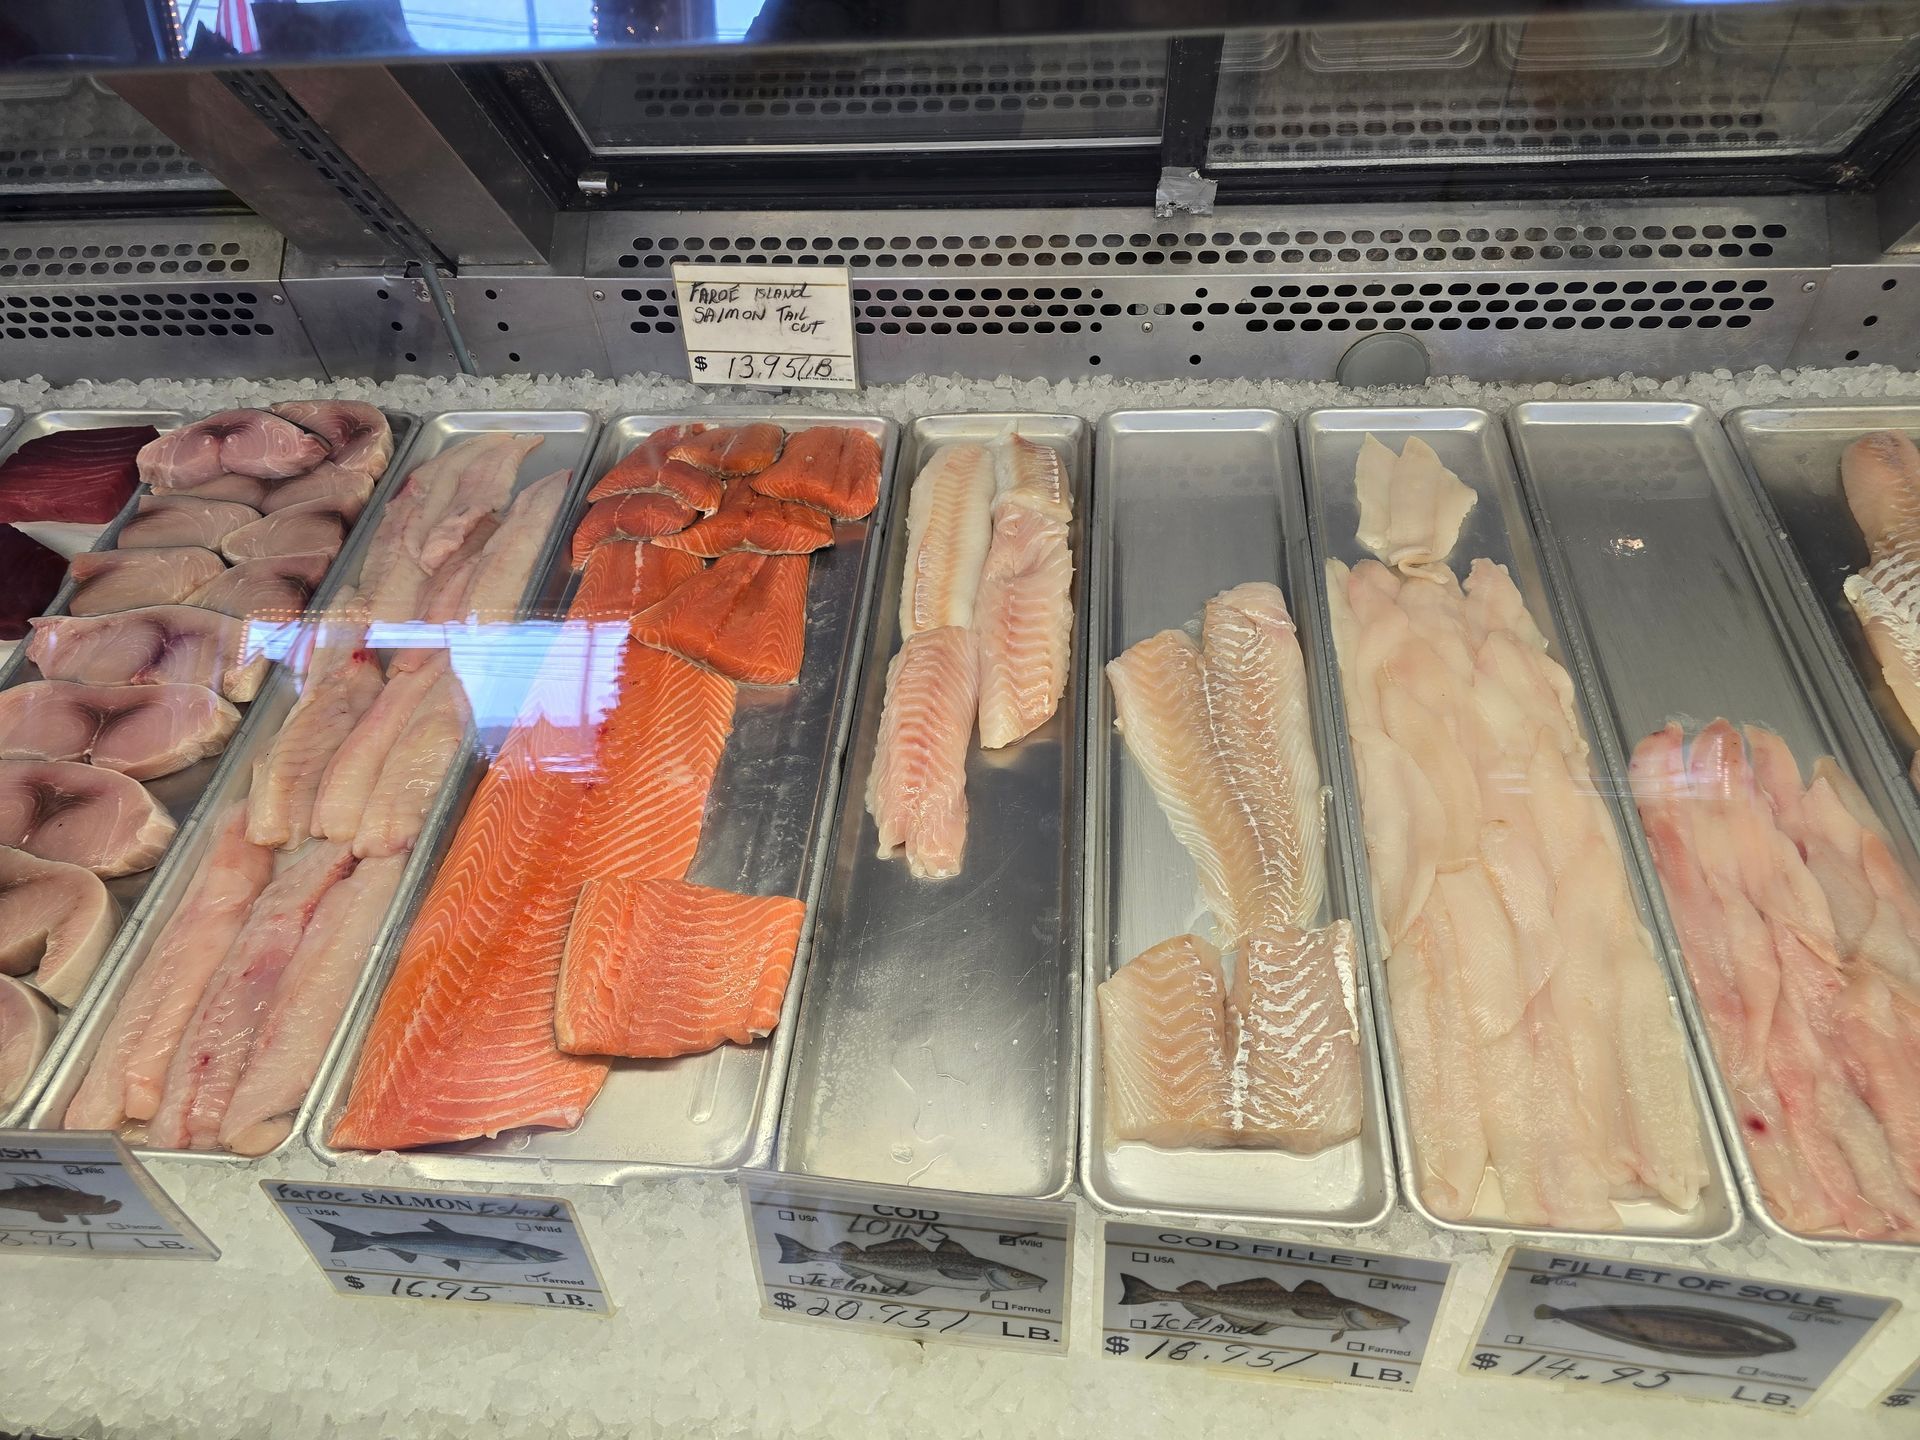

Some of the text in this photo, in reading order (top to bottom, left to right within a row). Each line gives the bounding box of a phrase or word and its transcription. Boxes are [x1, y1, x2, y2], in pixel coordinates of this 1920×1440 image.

[776, 305, 810, 323] TAIL
[791, 320, 825, 335] CUT
[694, 355, 708, 372] $
[361, 1191, 473, 1212] SALMON
[313, 1208, 340, 1217] USA
[798, 1214, 819, 1223] USA
[534, 1224, 563, 1234] Wild
[134, 1238, 194, 1250] LB.
[1019, 1239, 1043, 1248] Wild
[1158, 1233, 1380, 1268] COD FILLET
[1153, 1255, 1175, 1265] USA
[542, 1276, 585, 1286] Farmed
[1391, 1282, 1416, 1292] Wild
[1549, 1258, 1842, 1311] FILLET OF SOLE
[344, 1275, 365, 1290] $
[545, 1292, 593, 1307] LB.
[1011, 1304, 1051, 1314] Farmed
[774, 1292, 797, 1310] $
[1002, 1321, 1060, 1343] LB.
[1367, 1344, 1411, 1357] Farmed
[1105, 1336, 1129, 1355] $
[1350, 1362, 1411, 1384] LB.
[1472, 1353, 1500, 1370] $
[1731, 1385, 1797, 1408] LB.
